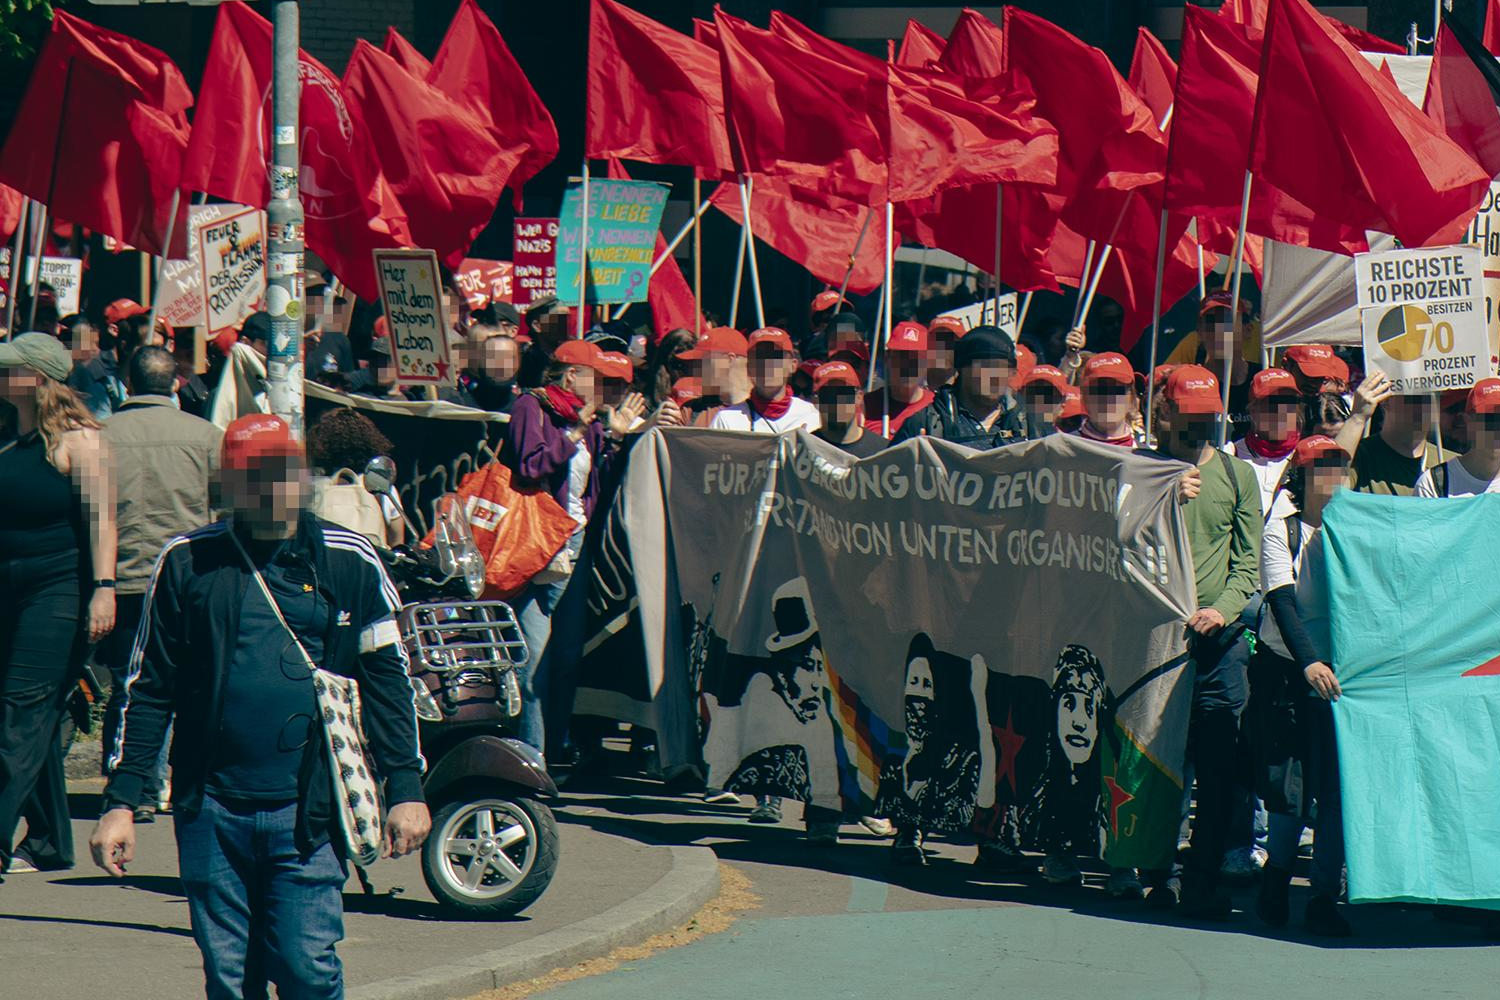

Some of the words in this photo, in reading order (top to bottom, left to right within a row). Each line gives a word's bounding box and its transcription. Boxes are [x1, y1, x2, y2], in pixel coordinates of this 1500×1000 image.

[602, 203, 653, 223] LIEBE
[206, 221, 241, 244] FEUER
[209, 269, 231, 288] DER
[1371, 256, 1465, 282] REICHSTE
[388, 284, 408, 306] mit
[411, 284, 435, 309] dem
[1368, 284, 1387, 303] 10
[1392, 278, 1472, 302] PROZENT
[1427, 302, 1473, 315] BESITZEN
[1416, 321, 1454, 354] 70
[1424, 356, 1476, 371] PROZENT
[1405, 372, 1474, 390] VERMÖGENS
[704, 454, 749, 495] FÜR
[915, 464, 984, 507] UND
[839, 520, 893, 558] VON
[900, 520, 999, 566] UNTEN
